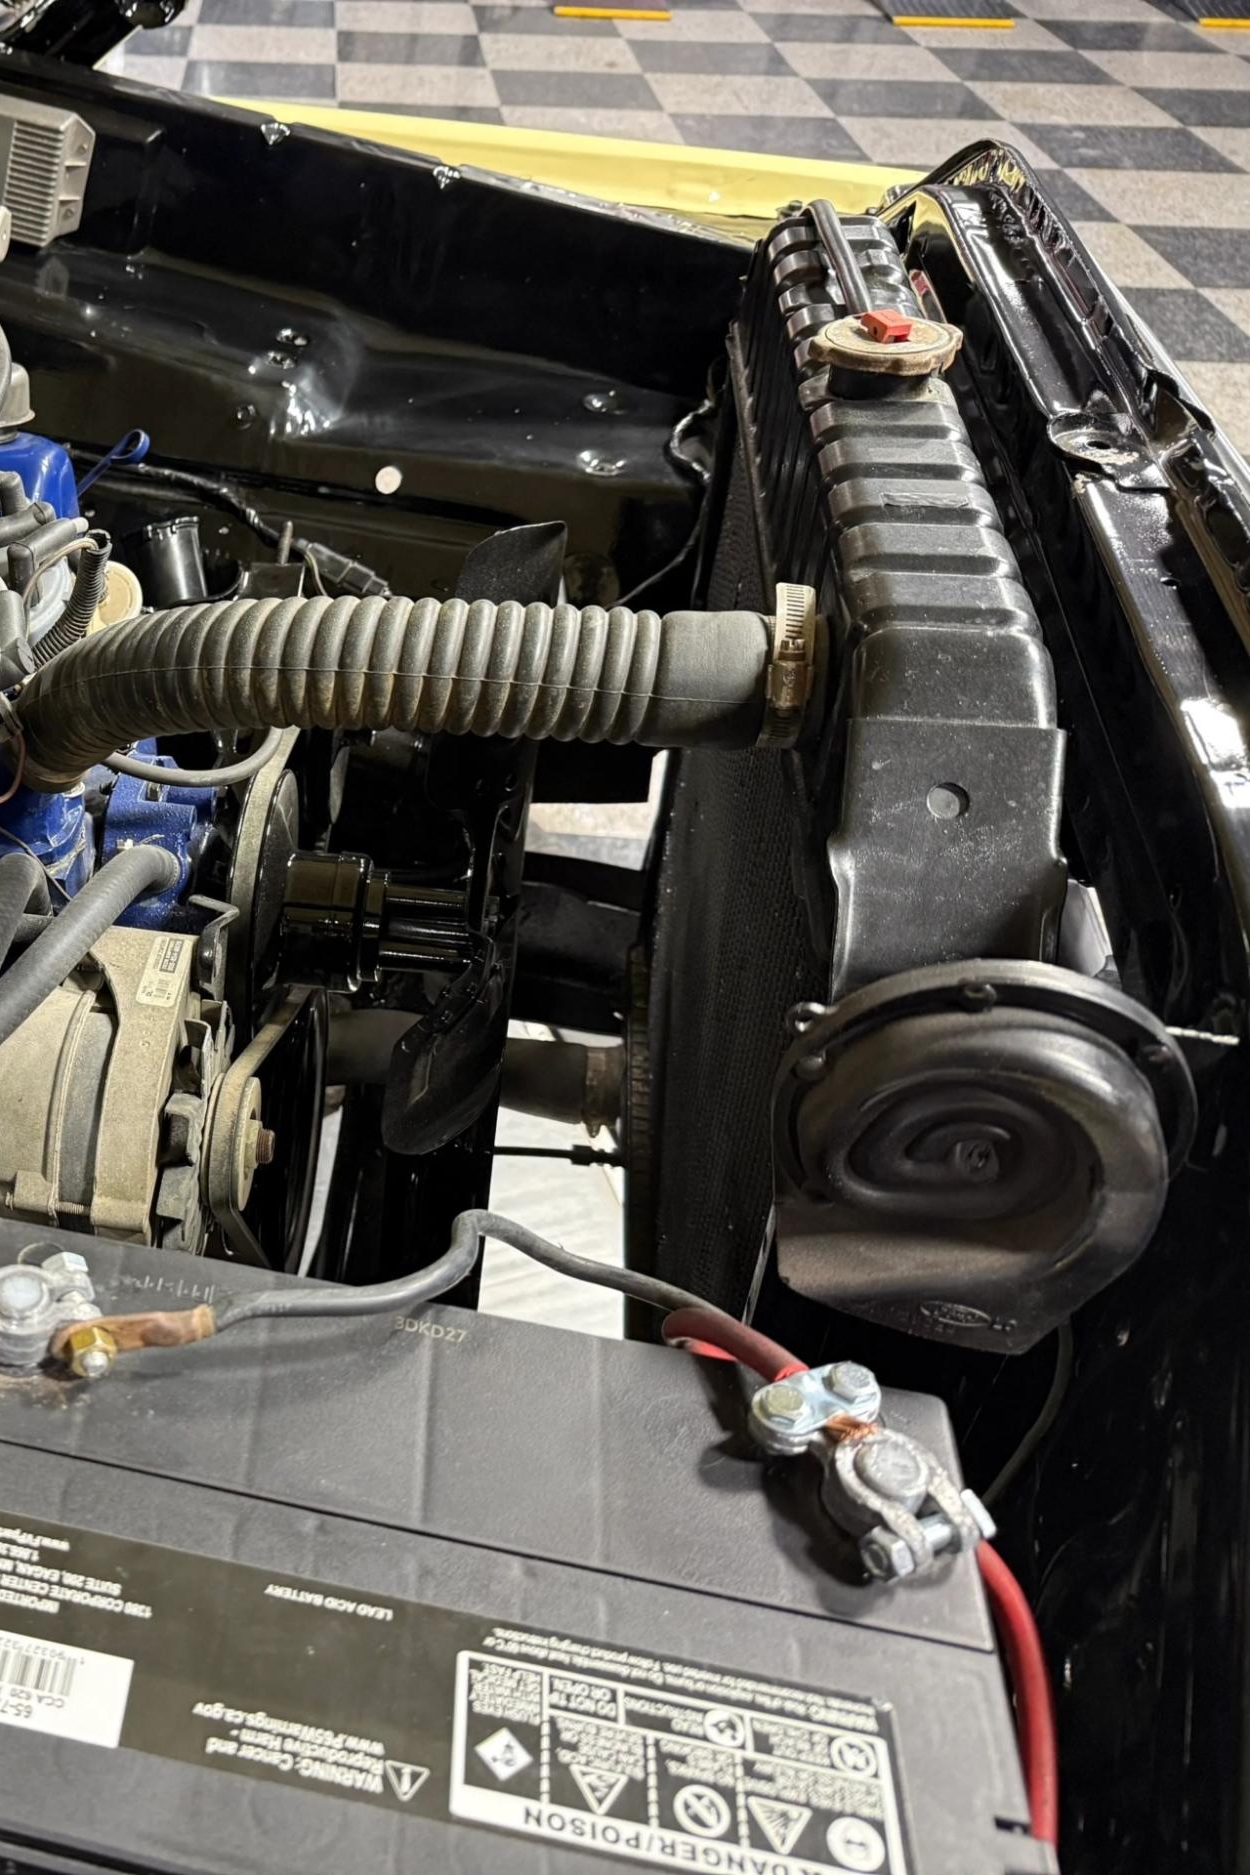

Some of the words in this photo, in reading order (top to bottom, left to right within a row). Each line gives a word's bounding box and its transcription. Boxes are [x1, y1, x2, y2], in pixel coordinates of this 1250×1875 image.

[14, 1560, 60, 1582] EAGAN,
[0, 1573, 49, 1595] CENTER
[84, 1576, 121, 1596] SUITE
[263, 1583, 323, 1606] BATTERY
[48, 1584, 124, 1612] CORPORATE
[323, 1596, 356, 1613] ACID
[355, 1603, 392, 1621] LEAD
[36, 1694, 64, 1709] CCA
[568, 1694, 594, 1712] NOT
[590, 1685, 610, 1701] OR
[597, 1699, 616, 1717] DO
[623, 1697, 703, 1722] INSTRUCTIONS
[191, 1701, 384, 1756] www.P65Warnings.ca.gov
[239, 1728, 282, 1750] Harm
[205, 1736, 237, 1755] and
[283, 1737, 384, 1776] Reproductive
[237, 1743, 293, 1771] Cancer
[294, 1756, 383, 1793] WARNING:
